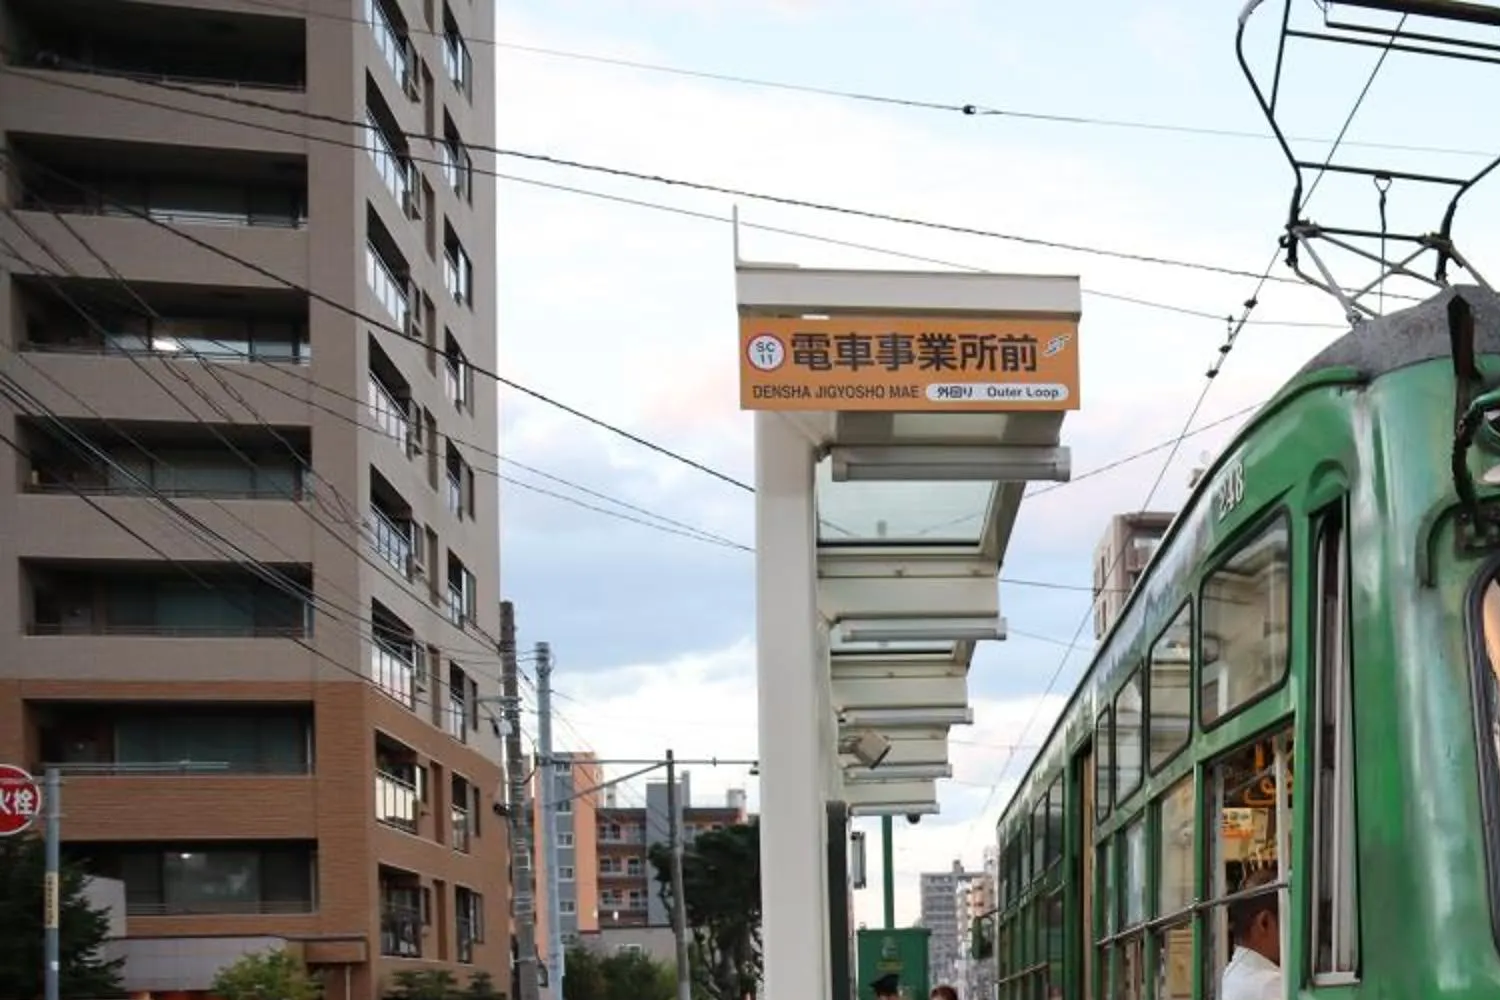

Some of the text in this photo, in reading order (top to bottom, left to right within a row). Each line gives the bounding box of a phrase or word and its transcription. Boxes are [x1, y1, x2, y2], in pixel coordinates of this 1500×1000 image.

[755, 341, 776, 353] SC
[791, 332, 1037, 372] 電車事業所前
[759, 354, 773, 365] 11
[752, 385, 919, 399] DENSHA JIGYOSHO MAE
[937, 386, 973, 399] 外回り
[987, 386, 1060, 400] Outer Loop
